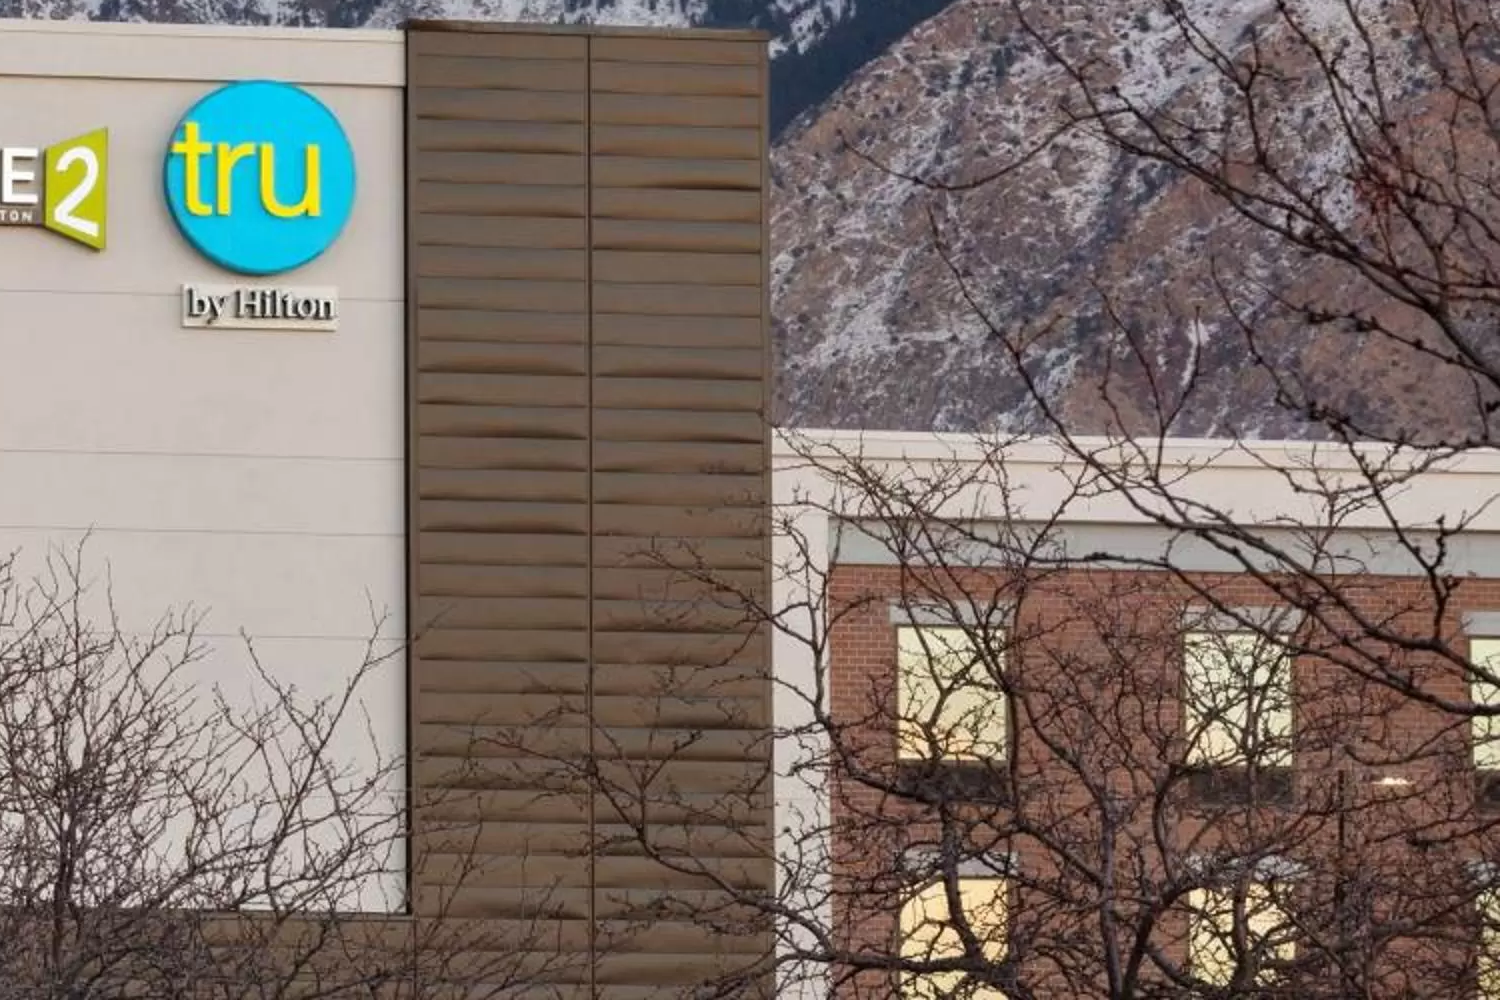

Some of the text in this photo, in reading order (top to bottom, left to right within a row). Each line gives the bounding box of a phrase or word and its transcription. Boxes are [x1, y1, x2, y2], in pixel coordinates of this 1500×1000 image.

[171, 121, 321, 218] tru
[188, 287, 335, 325] by Hilton
